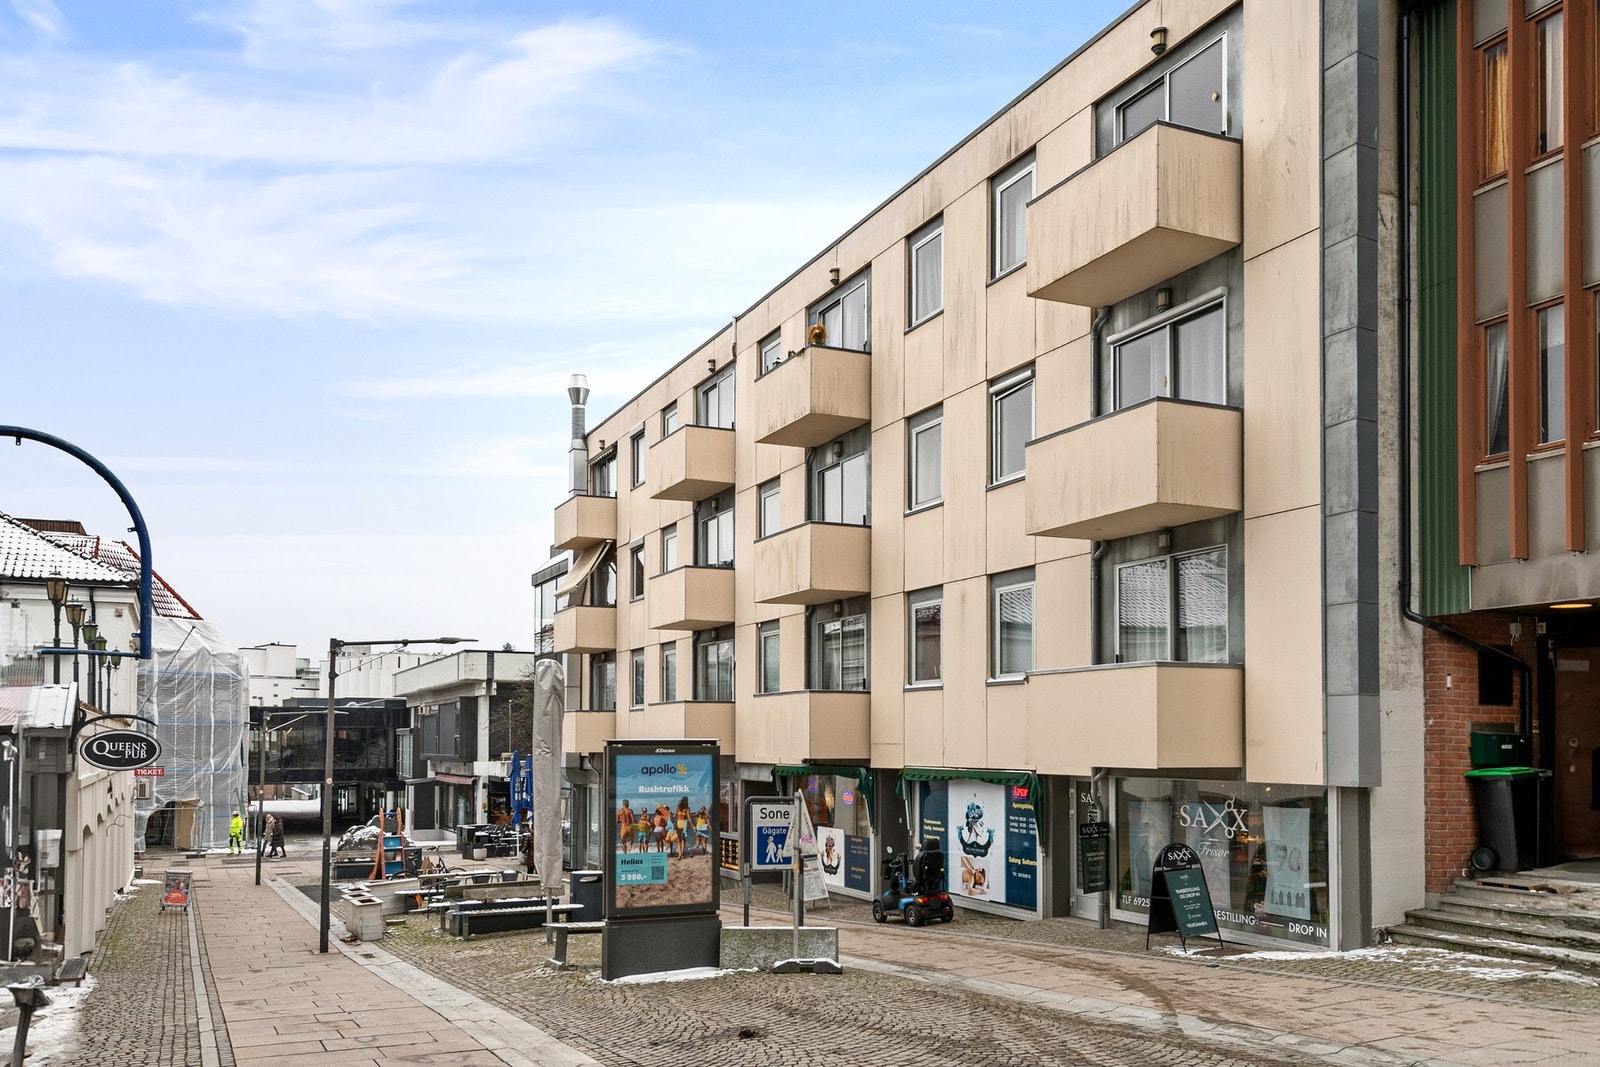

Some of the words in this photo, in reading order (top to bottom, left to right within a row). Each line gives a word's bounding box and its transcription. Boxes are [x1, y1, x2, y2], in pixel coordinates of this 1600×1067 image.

[93, 740, 147, 758] QUEENS
[125, 750, 147, 759] PUB
[641, 763, 677, 776] apollo
[638, 784, 690, 793] Rushtrafikk
[760, 807, 790, 819] Sone
[762, 827, 788, 836] Gågate
[621, 858, 644, 866] Hellas
[620, 873, 626, 881] 3
[627, 873, 647, 881] 998,-
[1121, 895, 1132, 904] TLF
[1288, 922, 1314, 936] DROP
[1316, 927, 1327, 939] IN
